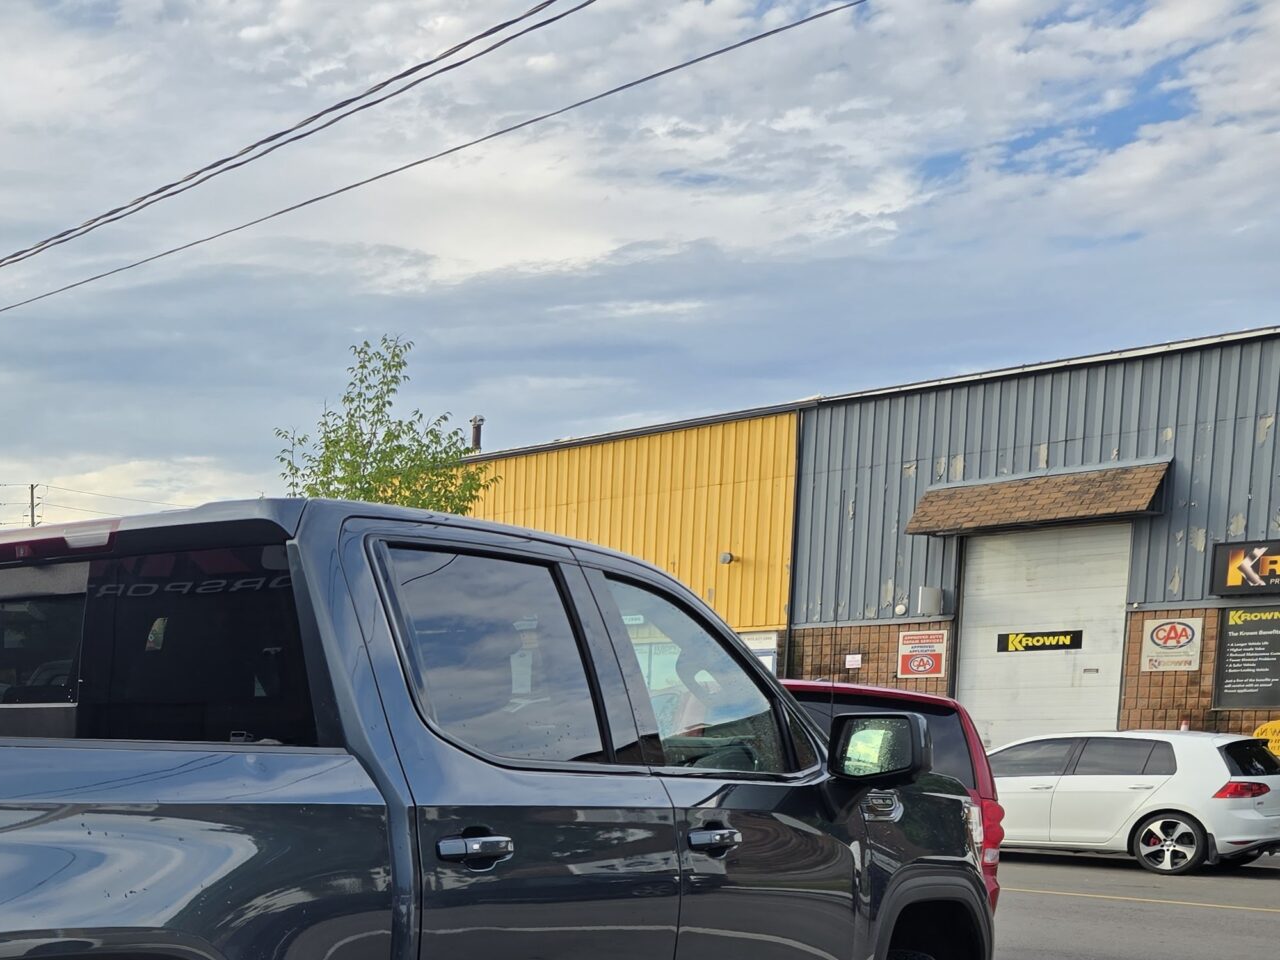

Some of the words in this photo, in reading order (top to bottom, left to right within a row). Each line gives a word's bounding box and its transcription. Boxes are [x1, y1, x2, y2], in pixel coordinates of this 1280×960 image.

[1226, 547, 1280, 587] KR
[1008, 633, 1071, 651] KROWN
[1155, 625, 1189, 645] CAA
